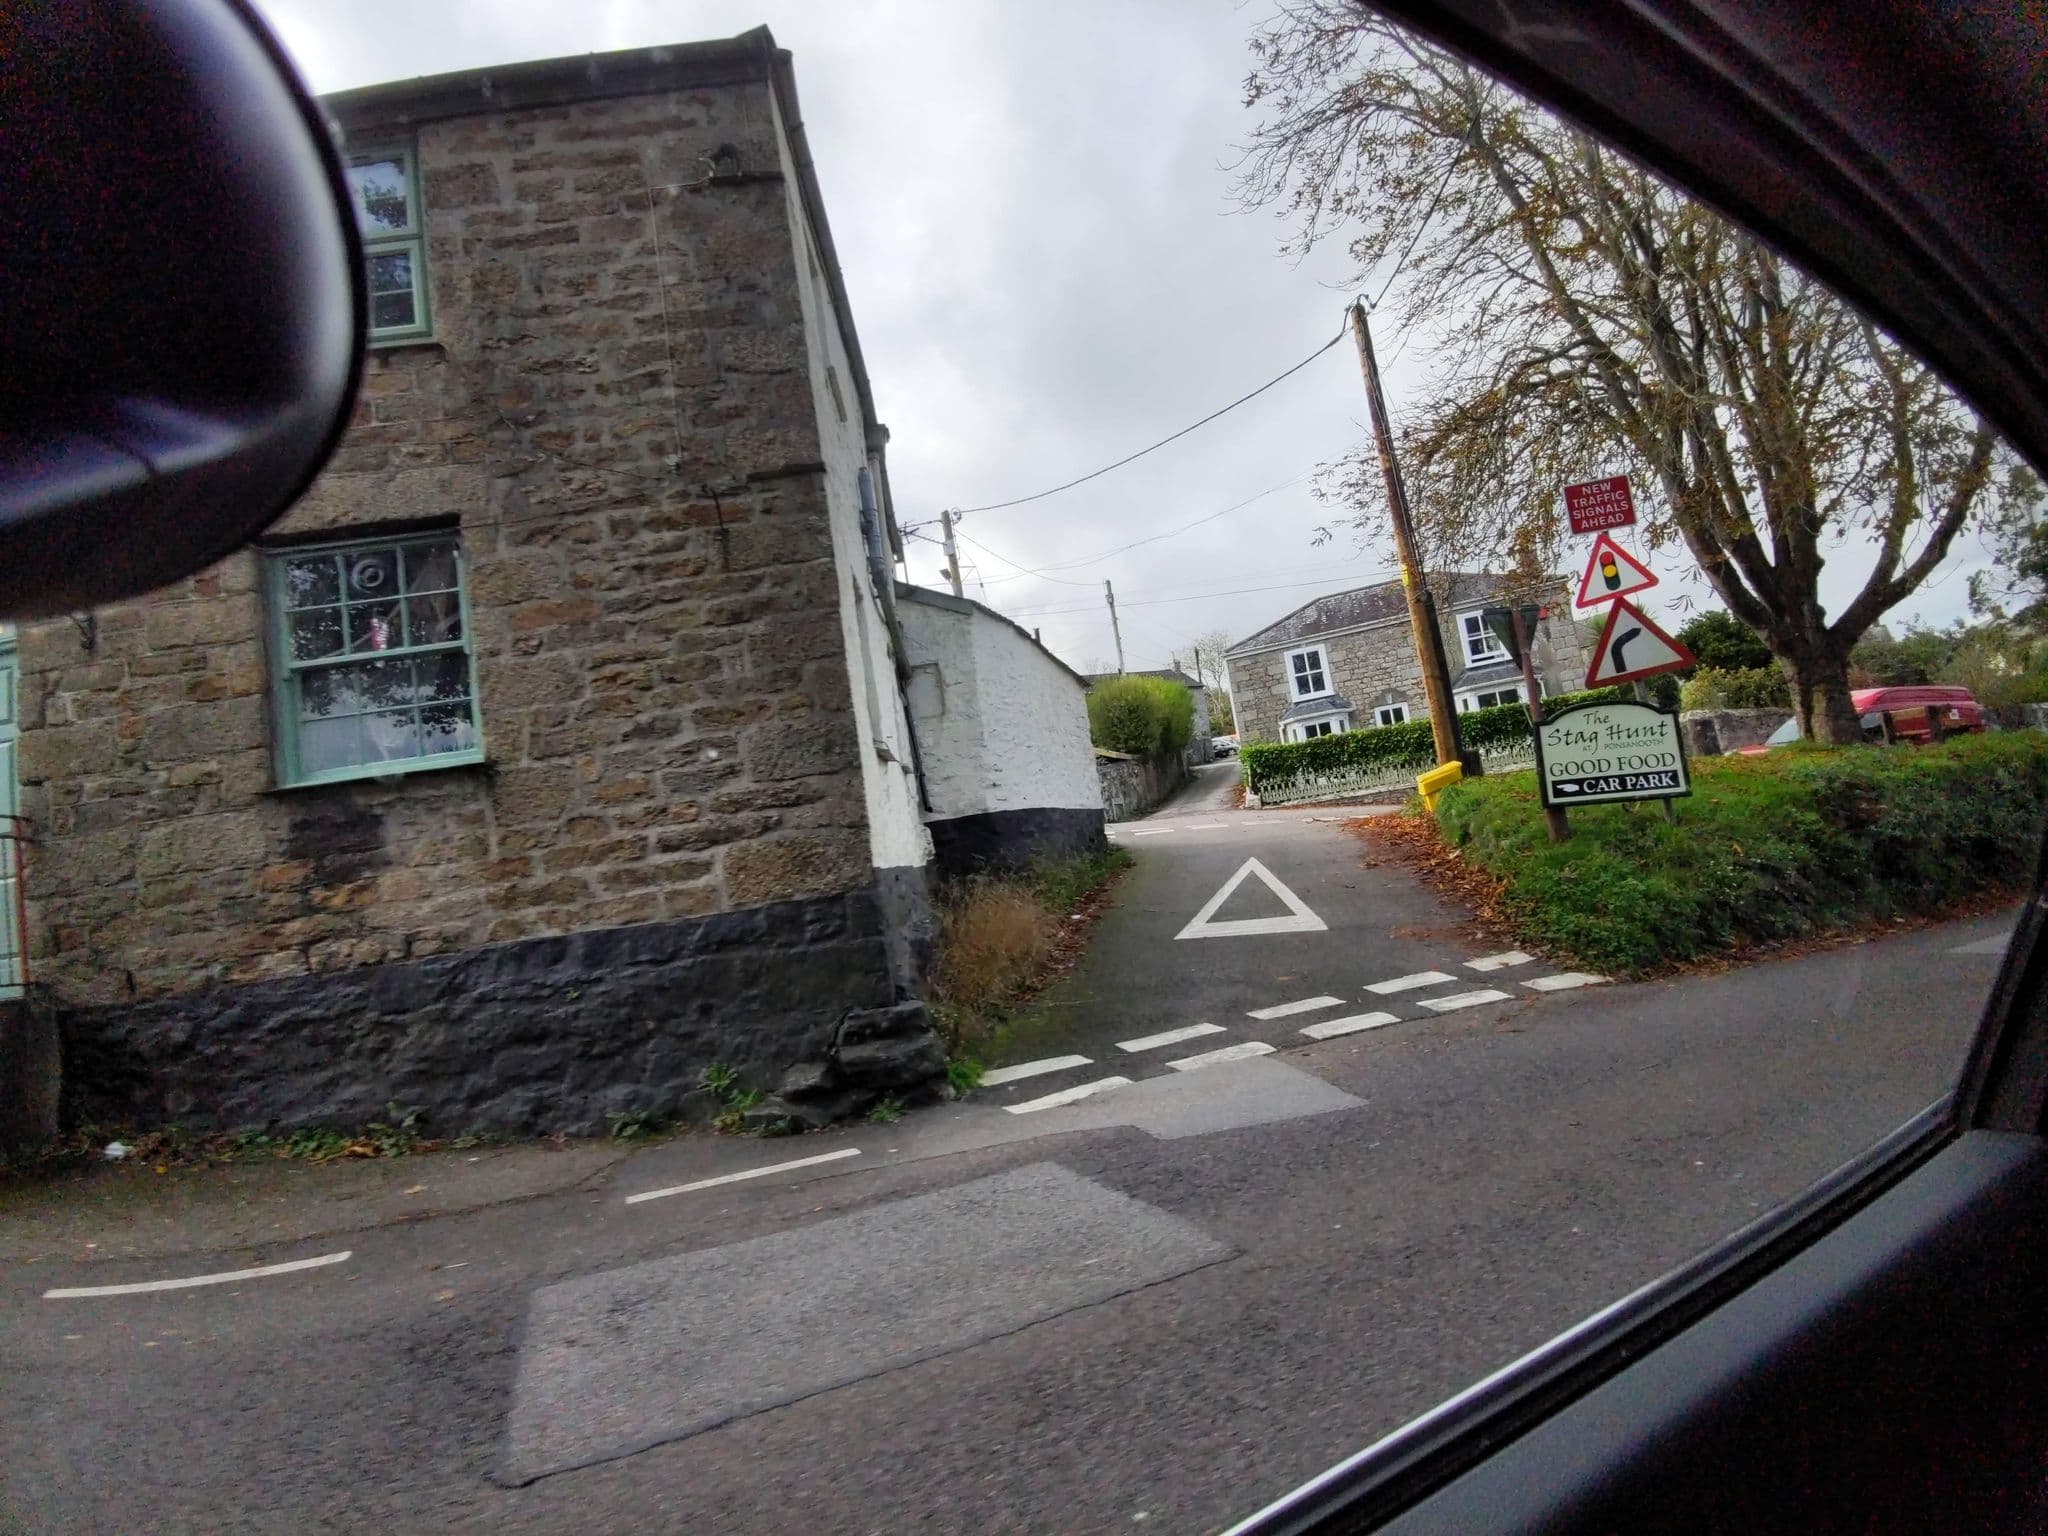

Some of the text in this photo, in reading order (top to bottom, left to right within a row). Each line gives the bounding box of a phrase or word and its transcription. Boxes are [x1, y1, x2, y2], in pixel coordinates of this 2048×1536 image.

[1582, 481, 1611, 495] NEW
[1572, 490, 1625, 508] TRAFFIC
[1573, 501, 1629, 519] SIGNALS
[1581, 513, 1625, 529] AHEAD
[1584, 710, 1610, 725] The
[1548, 720, 1669, 755] Stag Hunt
[1550, 752, 1676, 777] GOOD FOOD
[1583, 772, 1675, 793] CAR PARK
